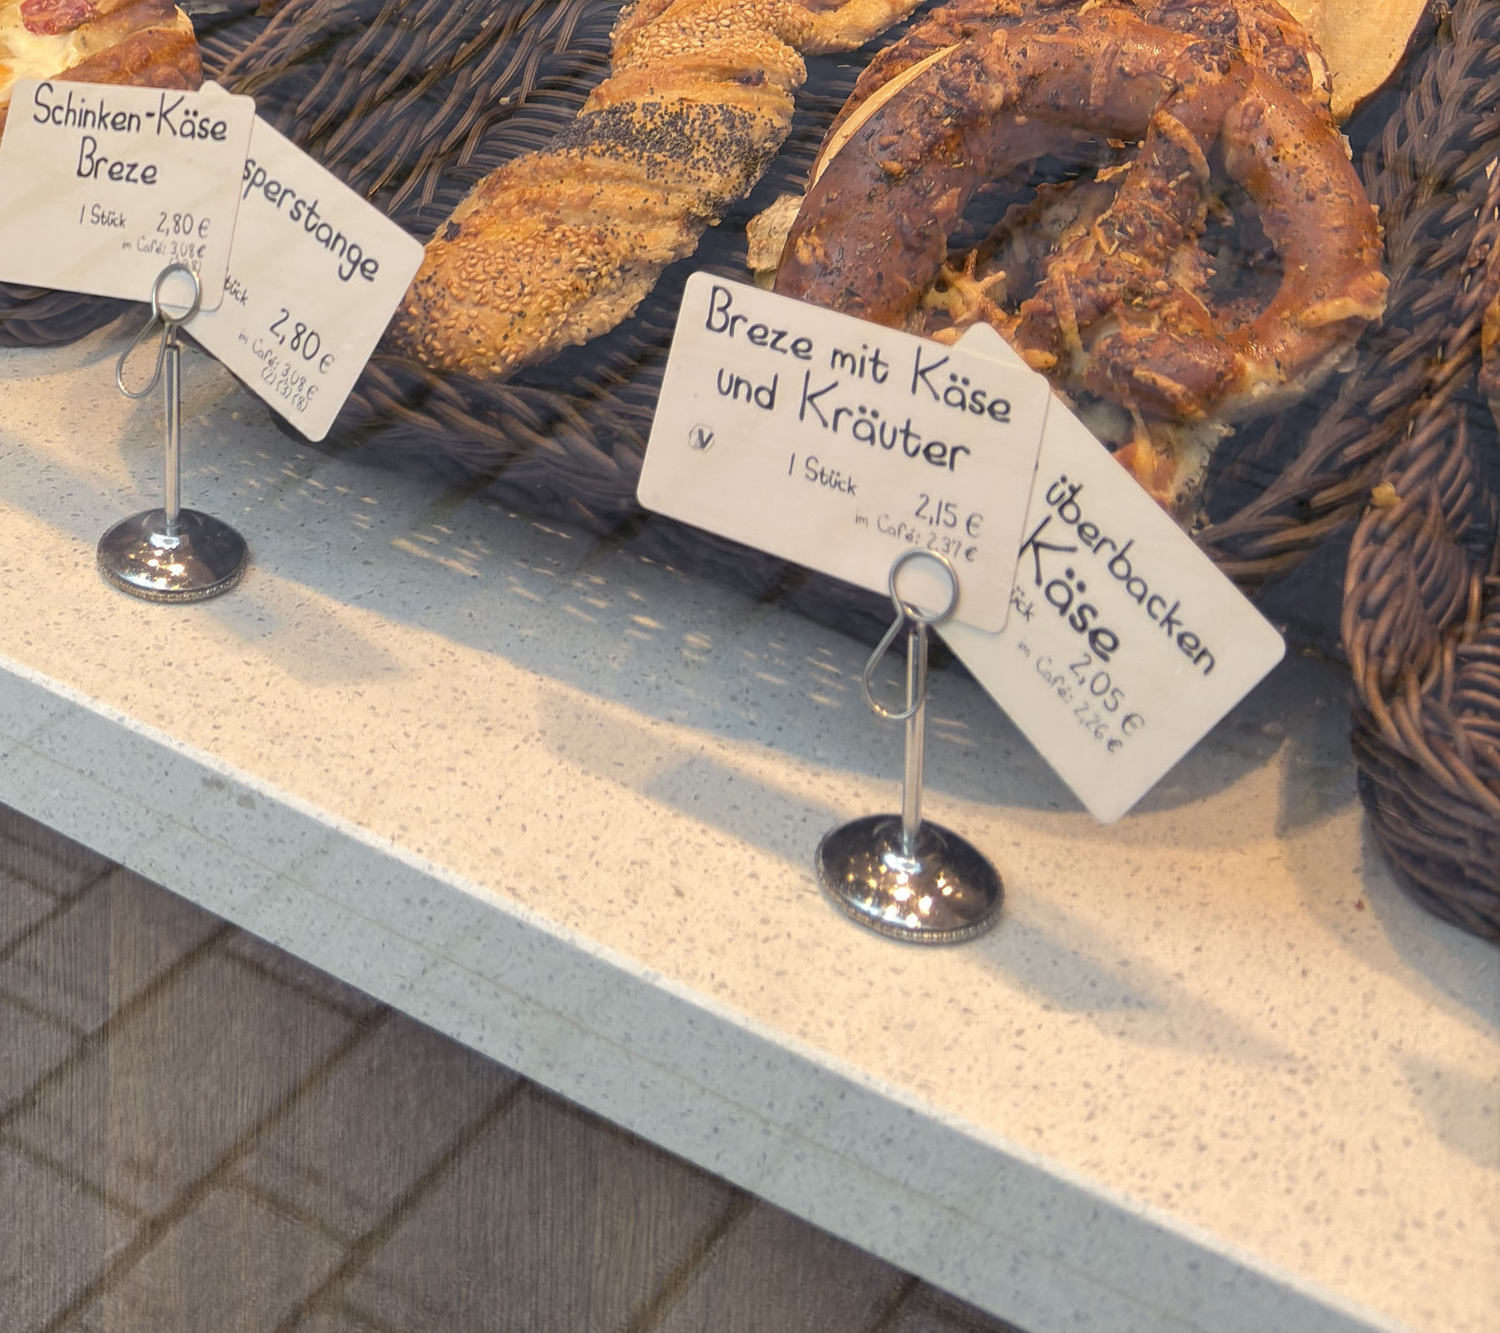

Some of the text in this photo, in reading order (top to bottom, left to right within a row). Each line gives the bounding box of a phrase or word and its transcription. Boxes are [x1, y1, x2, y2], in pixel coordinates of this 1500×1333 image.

[33, 82, 228, 141] Schinken-Käse
[76, 135, 158, 186] Breze
[90, 204, 126, 229] Stück
[156, 211, 211, 239] 2,80 €
[242, 159, 380, 282] sperstange
[224, 270, 249, 307] tück
[269, 307, 336, 375] 2,80 €
[705, 285, 1012, 424] Breze mit Käse
[716, 367, 972, 471] und Kräuter
[804, 455, 857, 497] Stück
[914, 494, 984, 538] 2,15 €
[1010, 586, 1036, 623] ück
[1018, 515, 1120, 663] Käse
[1045, 474, 1216, 677] überbacken
[1069, 652, 1145, 737] 2,05 €
